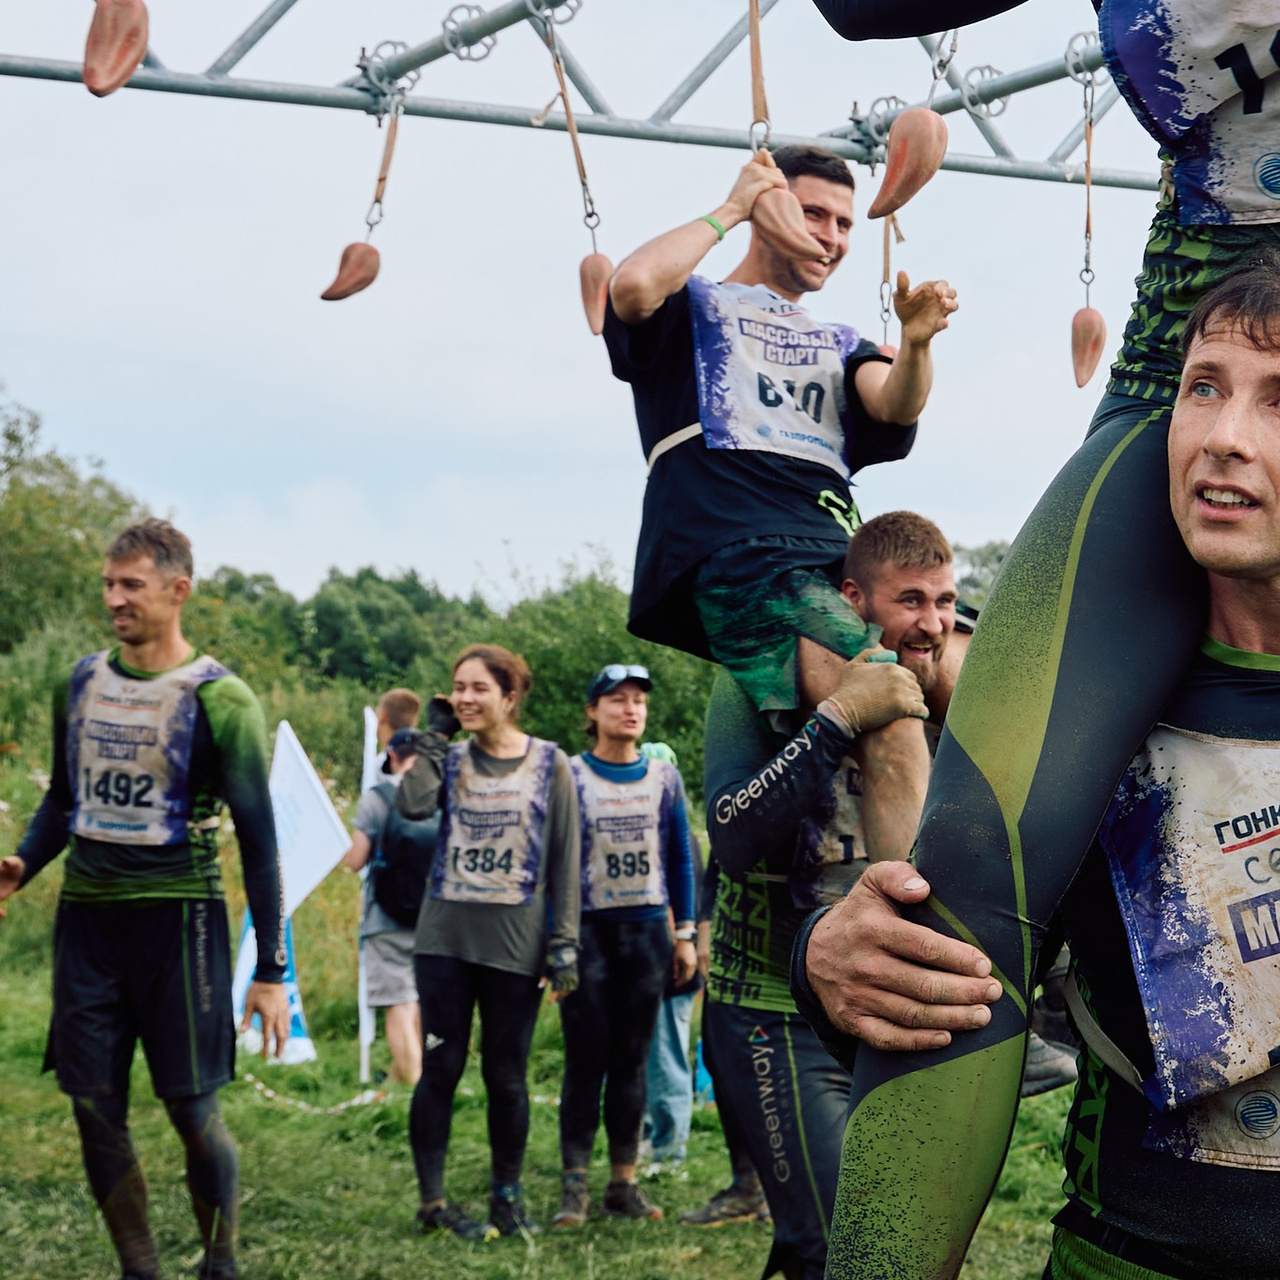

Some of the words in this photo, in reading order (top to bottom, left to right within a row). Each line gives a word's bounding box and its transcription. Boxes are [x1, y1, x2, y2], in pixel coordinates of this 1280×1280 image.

[765, 344, 816, 365] СТАРТ
[83, 767, 154, 808] 1492
[716, 728, 812, 824] Greenway
[452, 846, 513, 874] 1384
[606, 851, 650, 879] 895
[752, 1044, 791, 1183] Greenway
